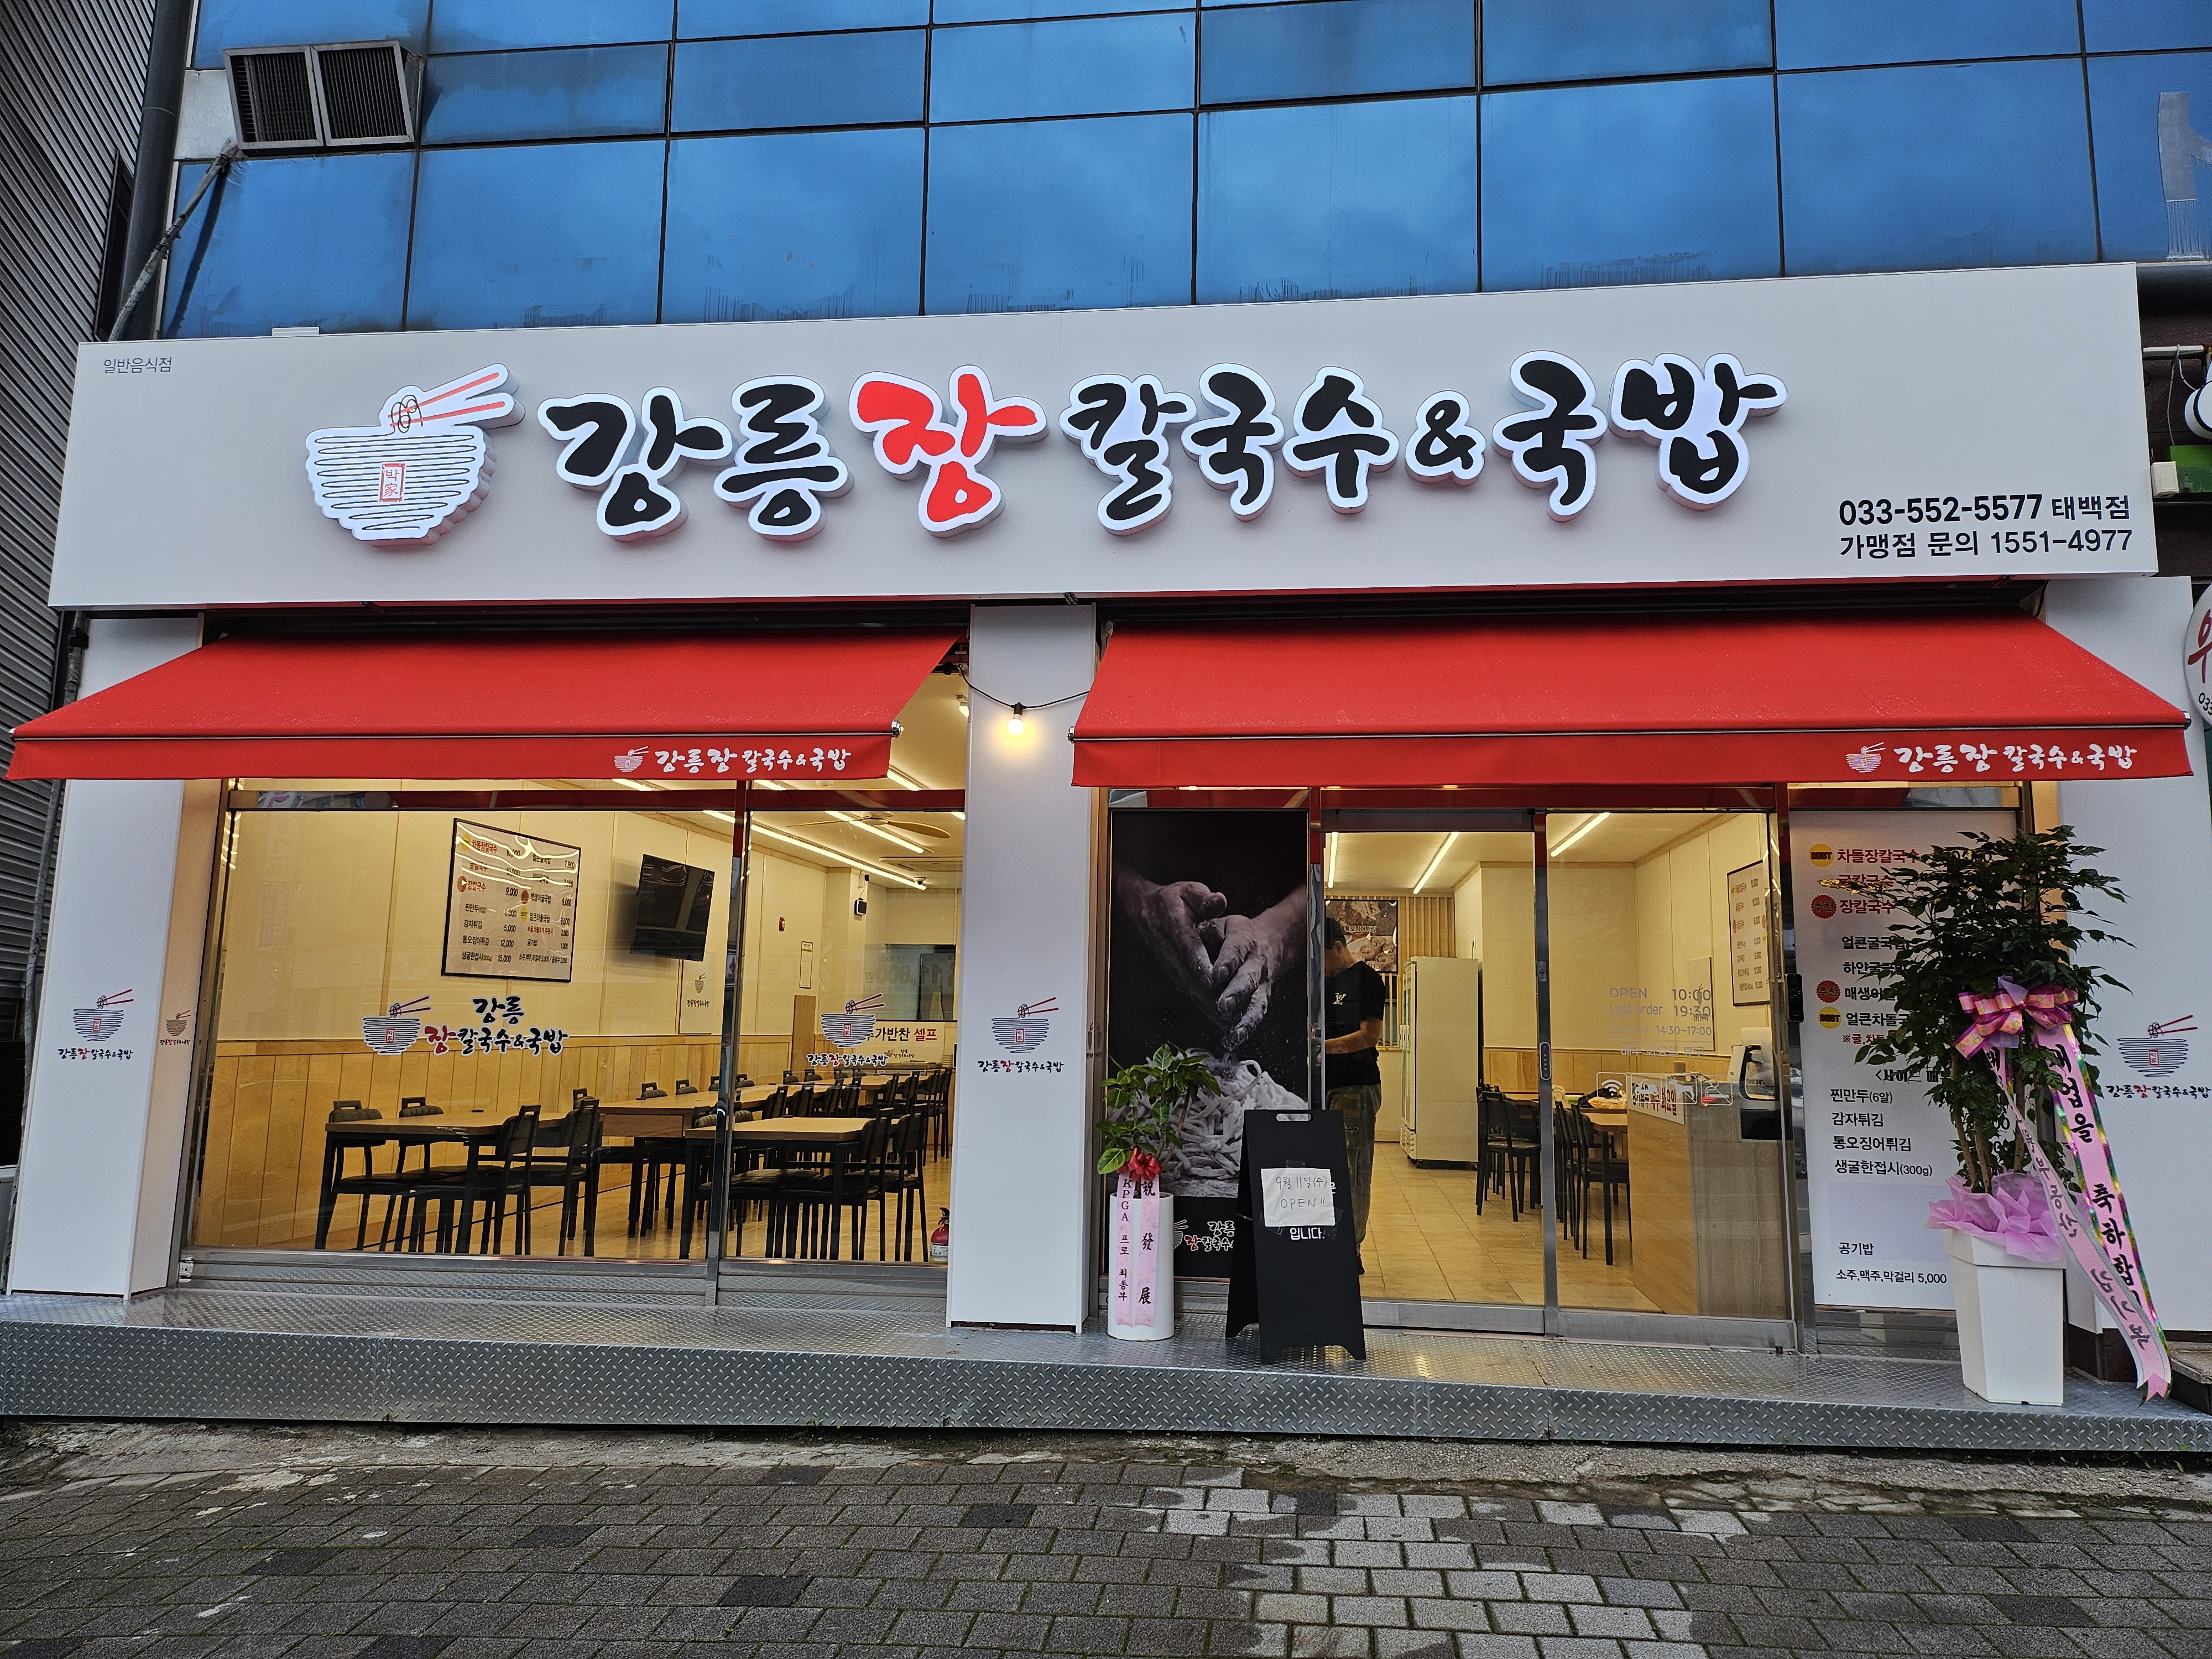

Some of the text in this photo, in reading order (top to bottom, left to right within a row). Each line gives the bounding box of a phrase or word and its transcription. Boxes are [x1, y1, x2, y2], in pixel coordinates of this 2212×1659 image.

[103, 356, 173, 374] 일반음식점
[1839, 494, 2130, 526] 033-552-5577 태백점
[1840, 529, 2132, 560] 가맹점 문의 1551-4977
[1837, 849, 1920, 863] 차돌장칼국수
[505, 887, 518, 896] 9,000
[1813, 900, 1896, 914] 추천 장칼국수
[504, 924, 516, 932] 5,000
[500, 940, 514, 948] 12,000
[498, 954, 512, 963] 15,000
[1609, 987, 1712, 1001] OPEN 10:00
[1818, 987, 1838, 997] 추천
[473, 996, 524, 1024] 강릉
[1673, 1005, 1711, 1017] 19:30
[914, 1028, 937, 1041] 셀프
[1656, 1025, 1712, 1035] 14:30~17:00
[1830, 1088, 1893, 1104] 찐만두(6알)
[1832, 1112, 1884, 1127] 감자튀김
[1833, 1135, 1911, 1152] 통오징어튀김
[1834, 1159, 1933, 1177] 생굴한접시(300g)
[1276, 1176, 1292, 1190] 9월
[1290, 1227, 1325, 1240] 입니다.
[1119, 1235, 1130, 1255] 프로
[1838, 1242, 1874, 1256] 공기밥
[1836, 1269, 1947, 1284] 소주,맥주,막걸리 5,000
